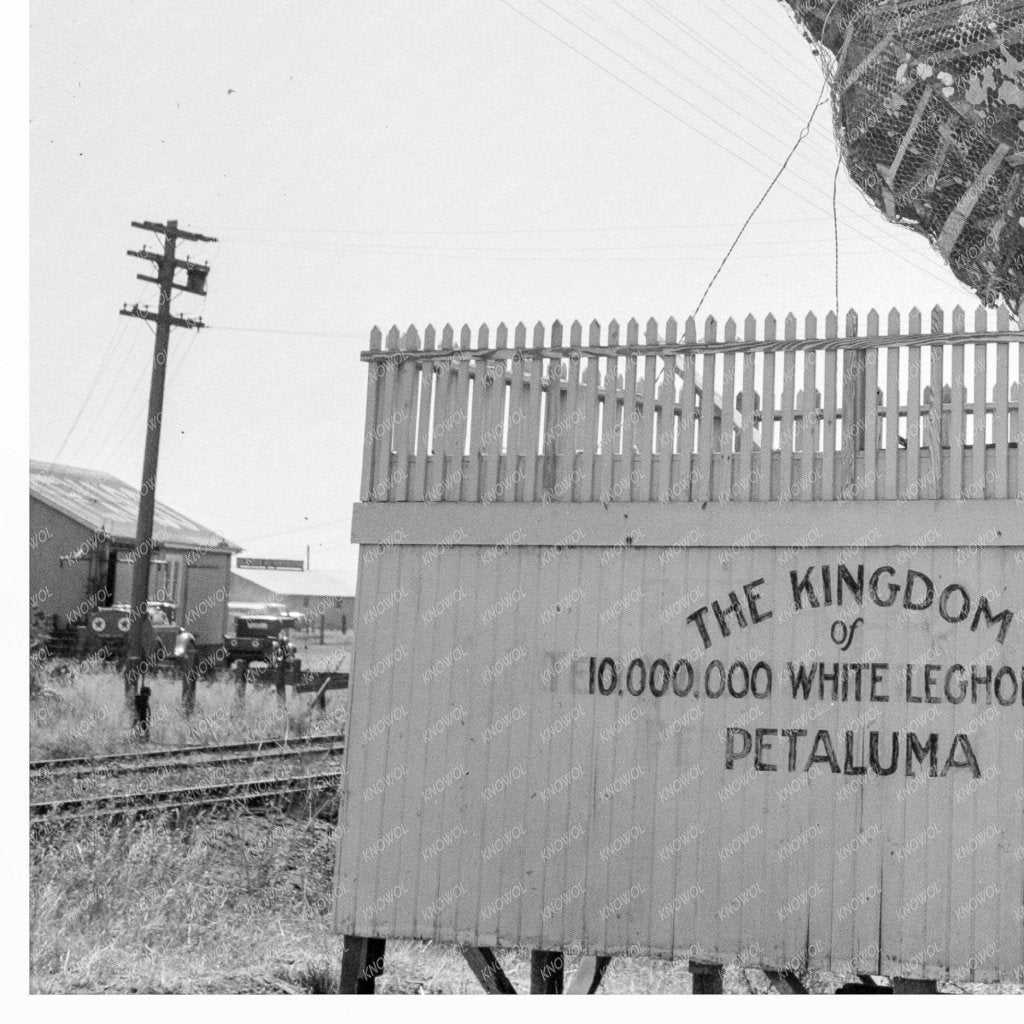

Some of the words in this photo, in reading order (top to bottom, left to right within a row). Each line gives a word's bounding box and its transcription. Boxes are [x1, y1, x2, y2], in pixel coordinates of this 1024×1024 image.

[687, 578, 772, 649] THE
[789, 564, 1014, 644] KINGDOM
[830, 618, 864, 651] of
[787, 662, 890, 703] WHITE
[725, 726, 982, 779] PETALUMA
